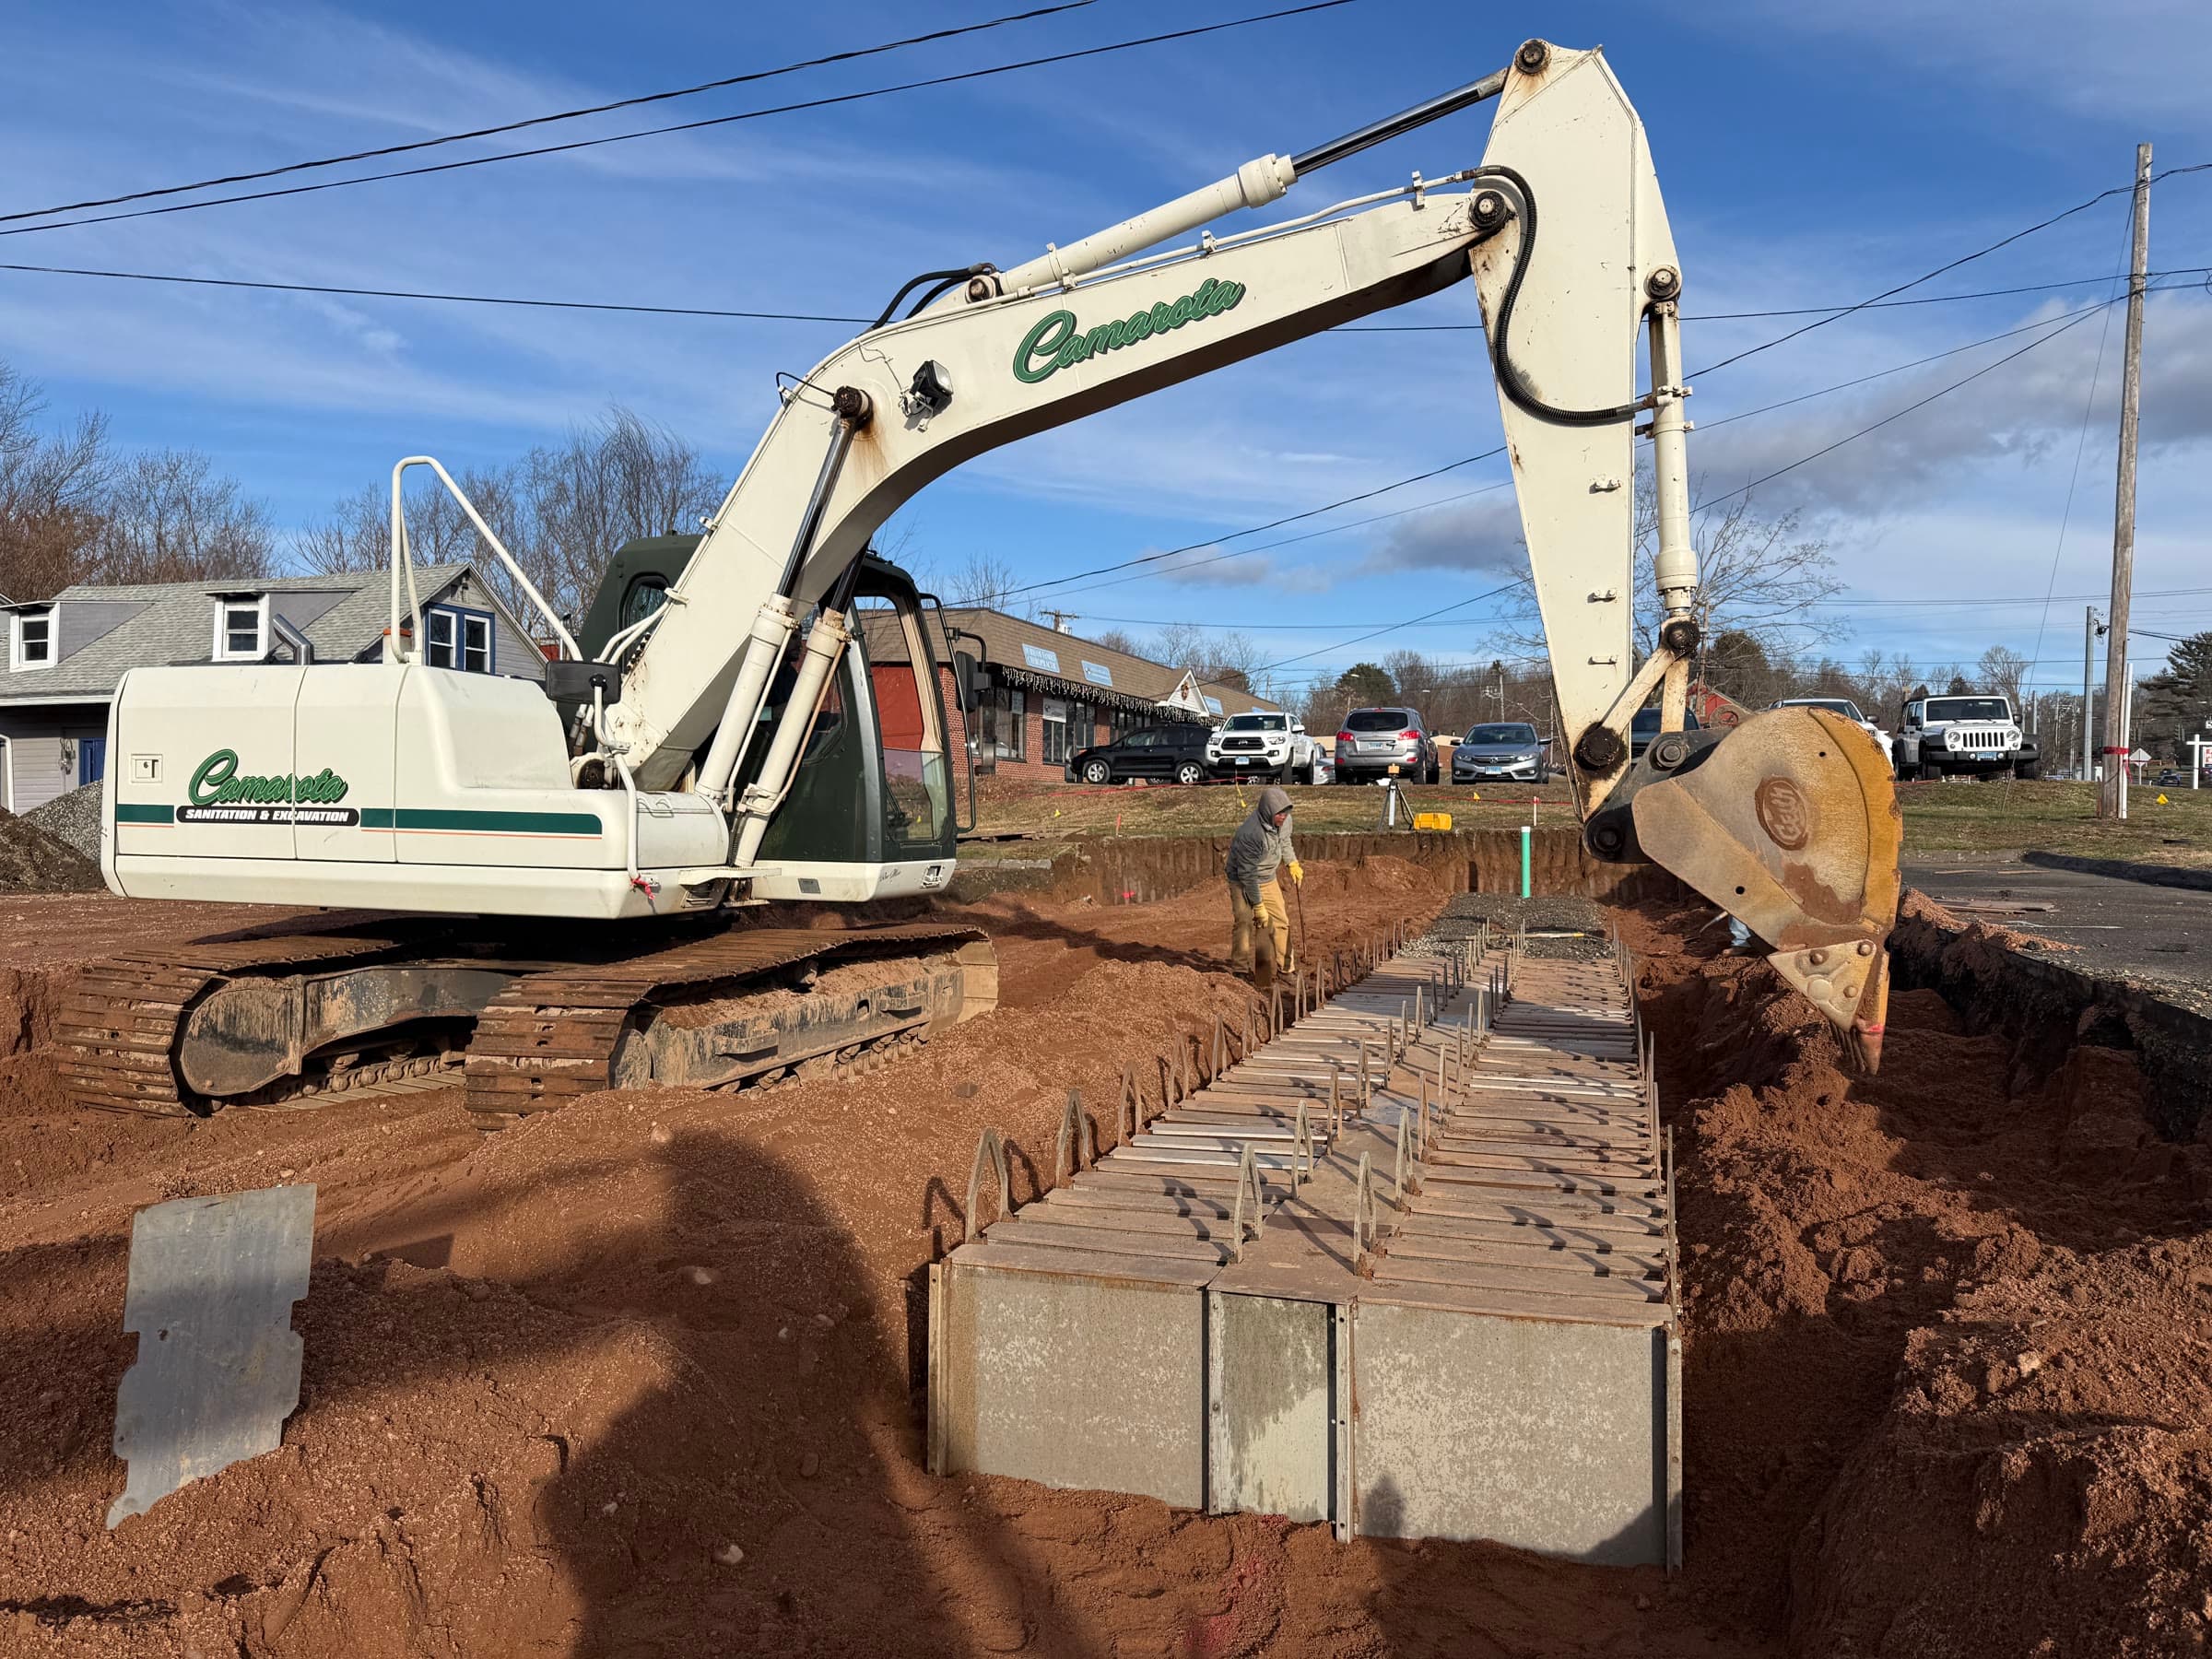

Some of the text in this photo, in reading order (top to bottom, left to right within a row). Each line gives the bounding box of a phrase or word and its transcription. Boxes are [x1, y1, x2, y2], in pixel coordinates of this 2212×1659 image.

[1014, 278, 1246, 383] Camarota
[188, 748, 348, 806] Camarota
[185, 809, 349, 822] SANITATION & EXCAVATION
